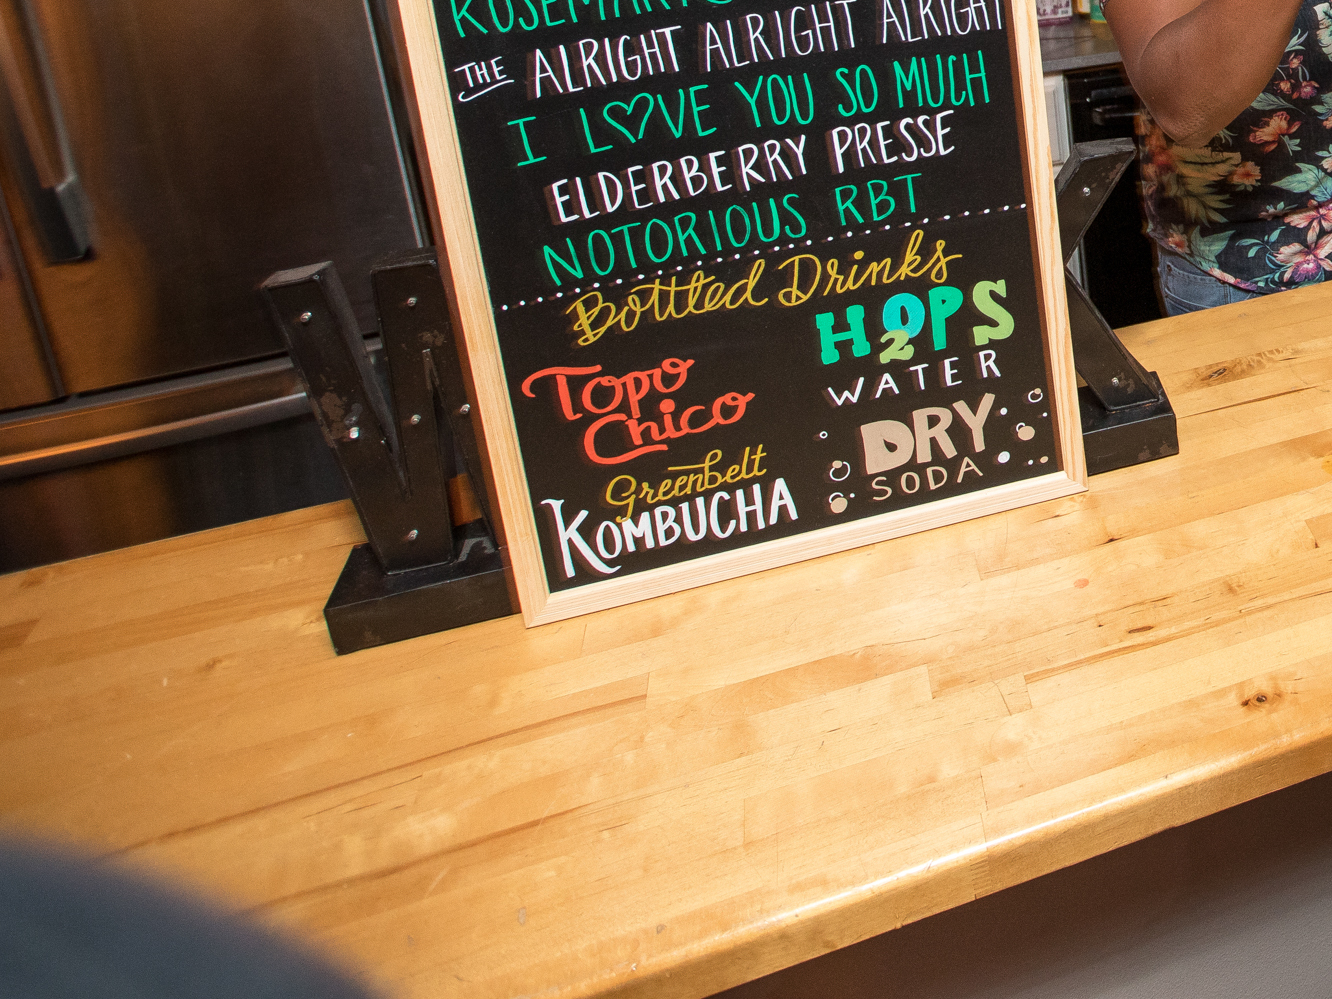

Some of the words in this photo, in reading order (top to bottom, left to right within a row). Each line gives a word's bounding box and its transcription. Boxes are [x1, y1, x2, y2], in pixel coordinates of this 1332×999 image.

[456, 56, 514, 93] THE
[536, 26, 681, 98] ALRIGHT
[707, 0, 856, 72] ALRIGHT
[508, 116, 547, 166] I
[734, 73, 814, 127] YOU
[836, 65, 878, 117] SO
[893, 50, 989, 108] MUCH
[553, 135, 806, 222] ELDERBERRY
[832, 110, 954, 173] PRESSE
[543, 194, 806, 286] NOTORIOUS
[835, 173, 921, 225] RBT
[778, 230, 962, 306] Drinks
[522, 357, 694, 422] Topo
[828, 350, 1001, 407] WATER
[583, 392, 755, 465] Chico
[860, 393, 995, 475] DRY
[606, 444, 767, 522] Greenbelt
[872, 457, 984, 501] SODA
[541, 478, 798, 578] KOMBUCHA
